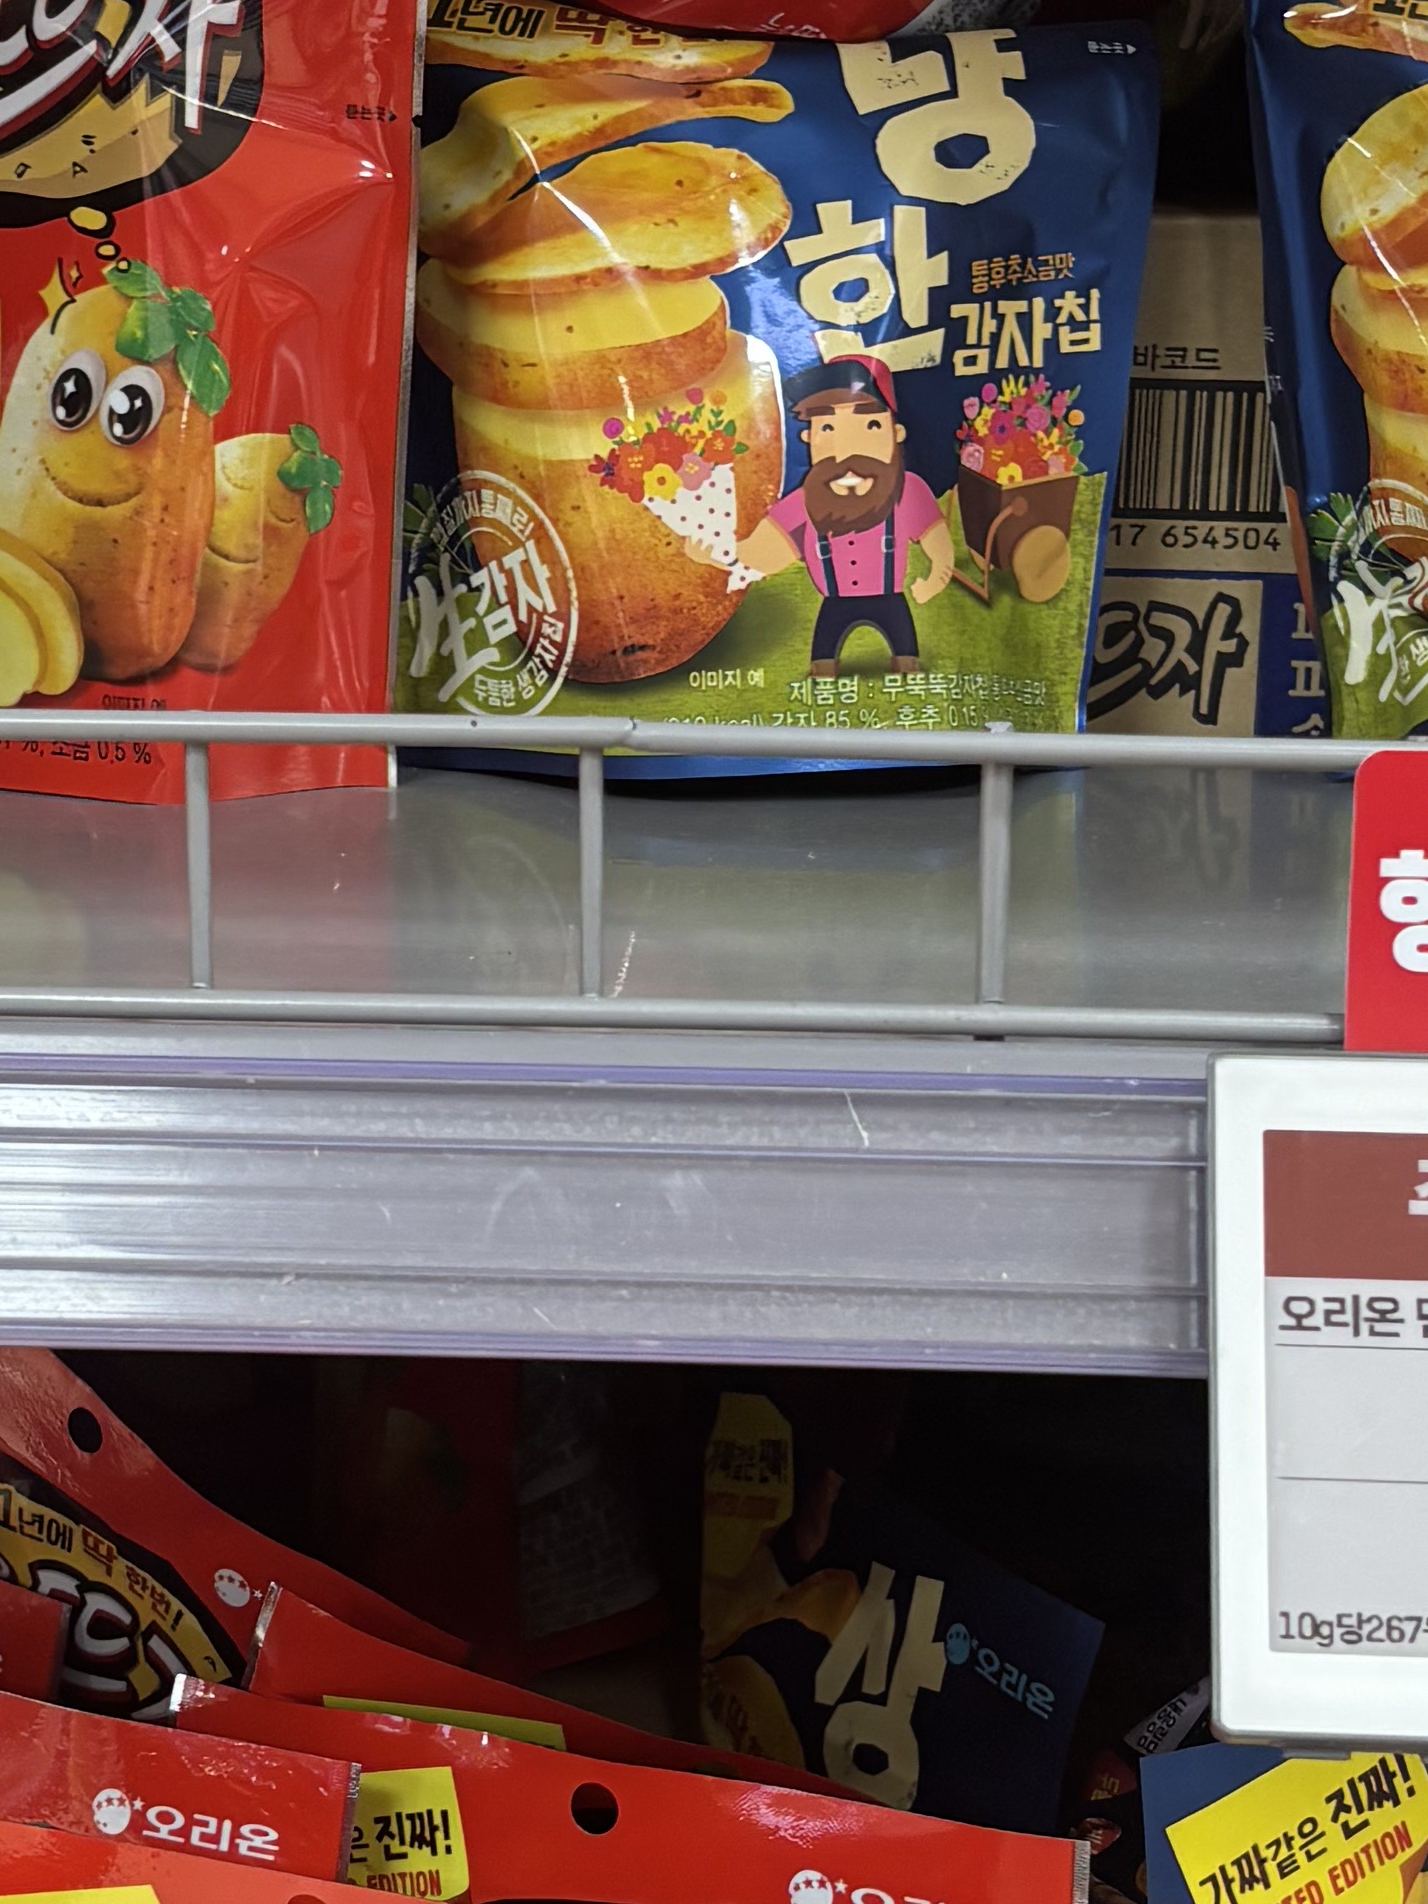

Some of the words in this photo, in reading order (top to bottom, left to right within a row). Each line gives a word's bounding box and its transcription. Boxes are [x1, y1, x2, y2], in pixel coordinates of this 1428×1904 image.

[971, 253, 1075, 293] 통후추소금맛
[950, 288, 1102, 376] 감자칩
[1133, 343, 1221, 373] 바코드
[1161, 522, 1282, 551] 654504
[688, 670, 741, 689] 이미지
[748, 668, 765, 689] 예
[789, 675, 860, 704] 제품명
[1278, 1293, 1405, 1338] 오리온
[82, 1527, 118, 1574] 딱
[126, 1565, 184, 1631] 한번!
[976, 1647, 1057, 1721] 오리온
[1326, 1752, 1417, 1840] 진짜!
[142, 1802, 279, 1860] 오리온
[374, 1807, 454, 1862] 진짜!
[1331, 1821, 1415, 1898] EDITION
